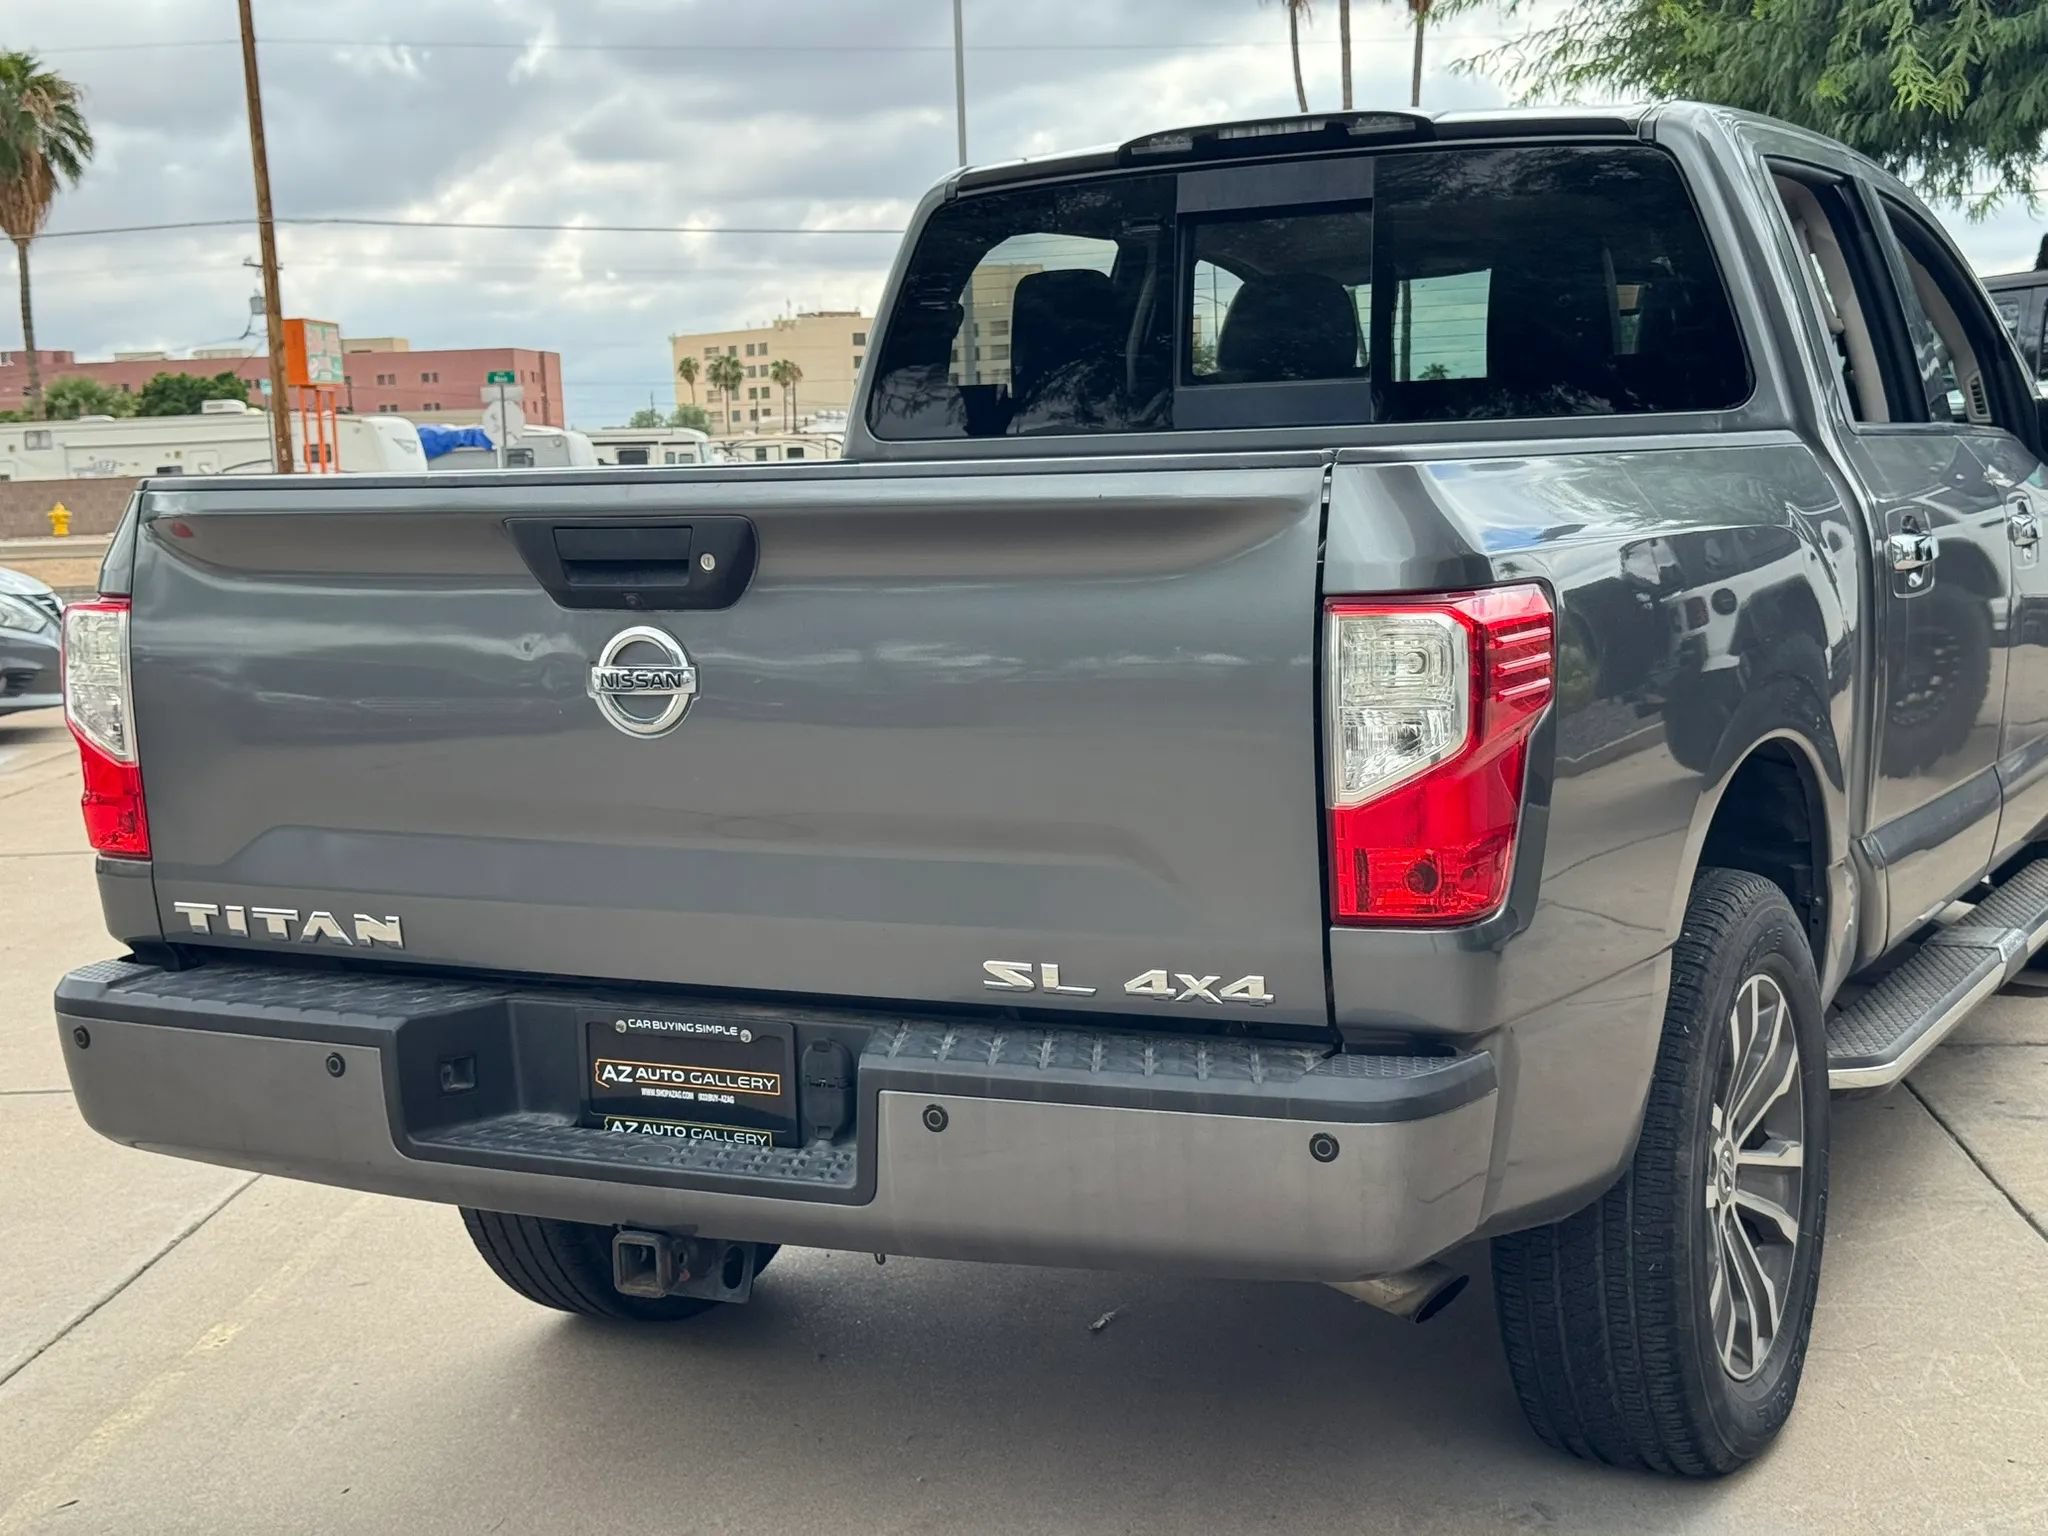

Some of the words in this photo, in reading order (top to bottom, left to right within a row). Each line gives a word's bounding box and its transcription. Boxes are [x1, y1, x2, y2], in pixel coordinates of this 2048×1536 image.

[600, 672, 681, 689] NISSAN
[174, 901, 404, 949] TITAN
[983, 960, 1097, 996] SL
[628, 1019, 651, 1029] CAR
[652, 1020, 694, 1032] BUYING
[695, 1024, 738, 1036] SIMPLE
[602, 1065, 633, 1082] AZ
[635, 1067, 684, 1082] AUTO
[689, 1072, 775, 1090] GALLERY
[641, 1124, 686, 1137] AUTO
[691, 1128, 767, 1146] GALLERY
